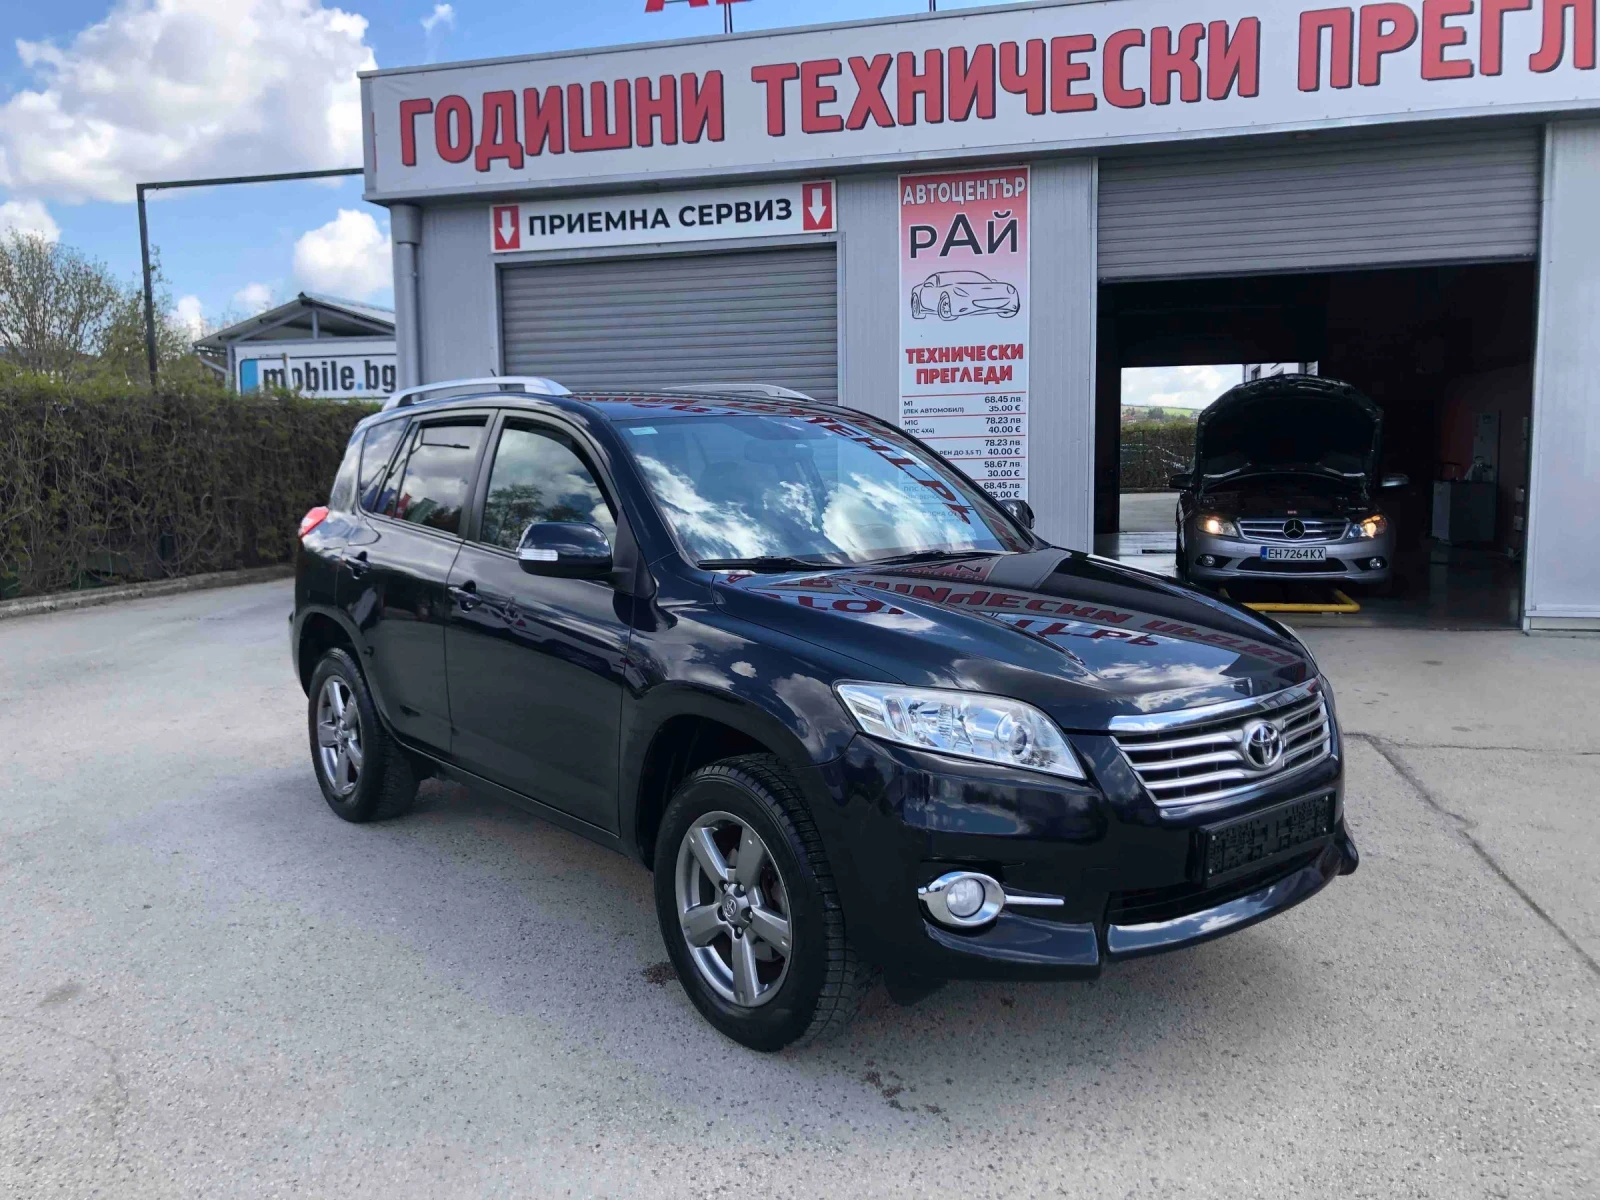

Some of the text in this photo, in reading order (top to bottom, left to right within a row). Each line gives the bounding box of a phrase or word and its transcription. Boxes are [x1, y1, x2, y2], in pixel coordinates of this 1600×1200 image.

[400, 0, 1598, 173] ГОДИШНИ ТЕХНИЧЕСКИ ПРЕГЛ
[902, 177, 1026, 205] АВТОЦЕНТЪР
[528, 198, 793, 237] ПРИЕМНА СЕРВИЗ
[909, 209, 1019, 259] РАЙ
[905, 343, 1024, 365] ТЕХНИЧЕСКИ
[916, 365, 1013, 385] ПРЕГЛЕДИ
[984, 395, 1009, 404] 68.45
[988, 404, 1013, 412] 35.00
[985, 416, 1009, 425] 78.23
[988, 425, 1021, 433] 40.00 €
[984, 438, 1008, 447] 78.23
[987, 447, 1020, 456] 40.00 €
[984, 460, 1008, 468] 58.67
[987, 469, 1020, 477] 30.00 €
[983, 481, 1008, 490] 68.45
[1013, 490, 1020, 498] €
